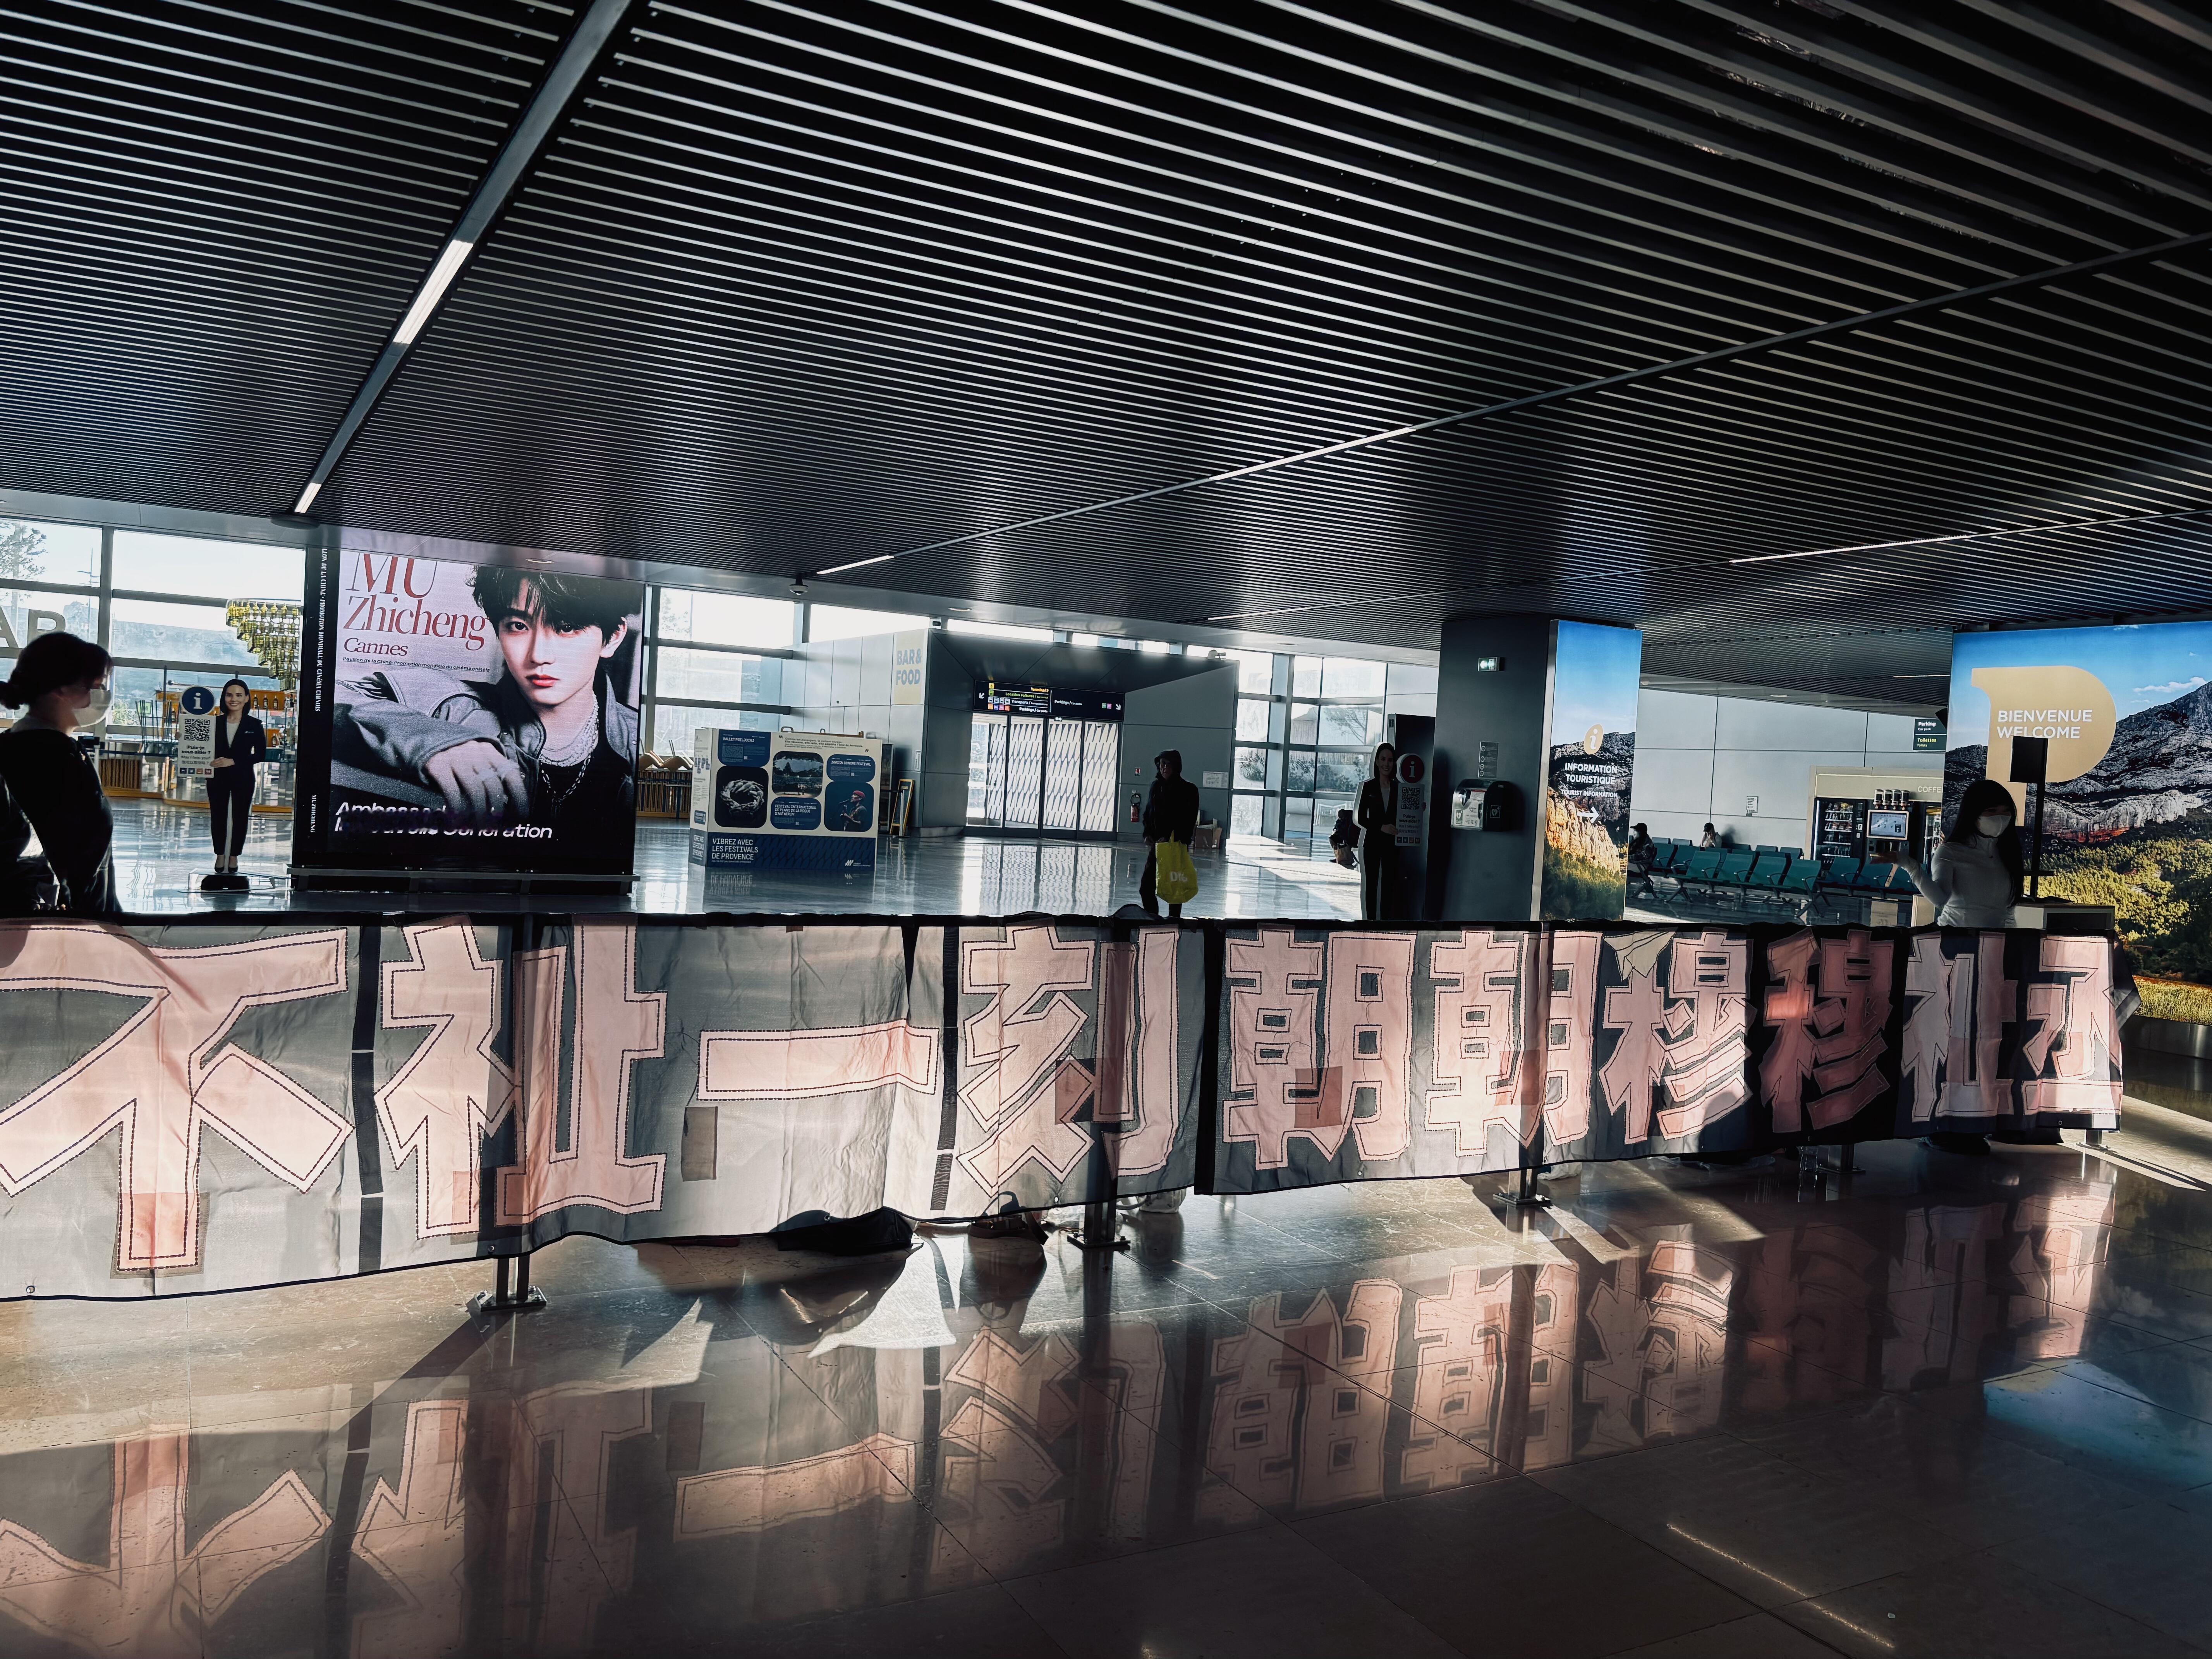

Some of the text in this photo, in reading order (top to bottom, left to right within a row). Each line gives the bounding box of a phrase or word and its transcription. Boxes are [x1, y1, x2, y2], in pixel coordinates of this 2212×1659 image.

[345, 553, 438, 598] MU
[343, 594, 489, 651] Zhicheng
[344, 637, 408, 656] Cannes
[896, 669, 921, 685] FOOD
[1998, 709, 2093, 723] BIENVENUE
[1997, 726, 2081, 739] WELCOME
[1565, 763, 1617, 774] INFORMATION
[1566, 774, 1616, 785] TOURISTIQUE
